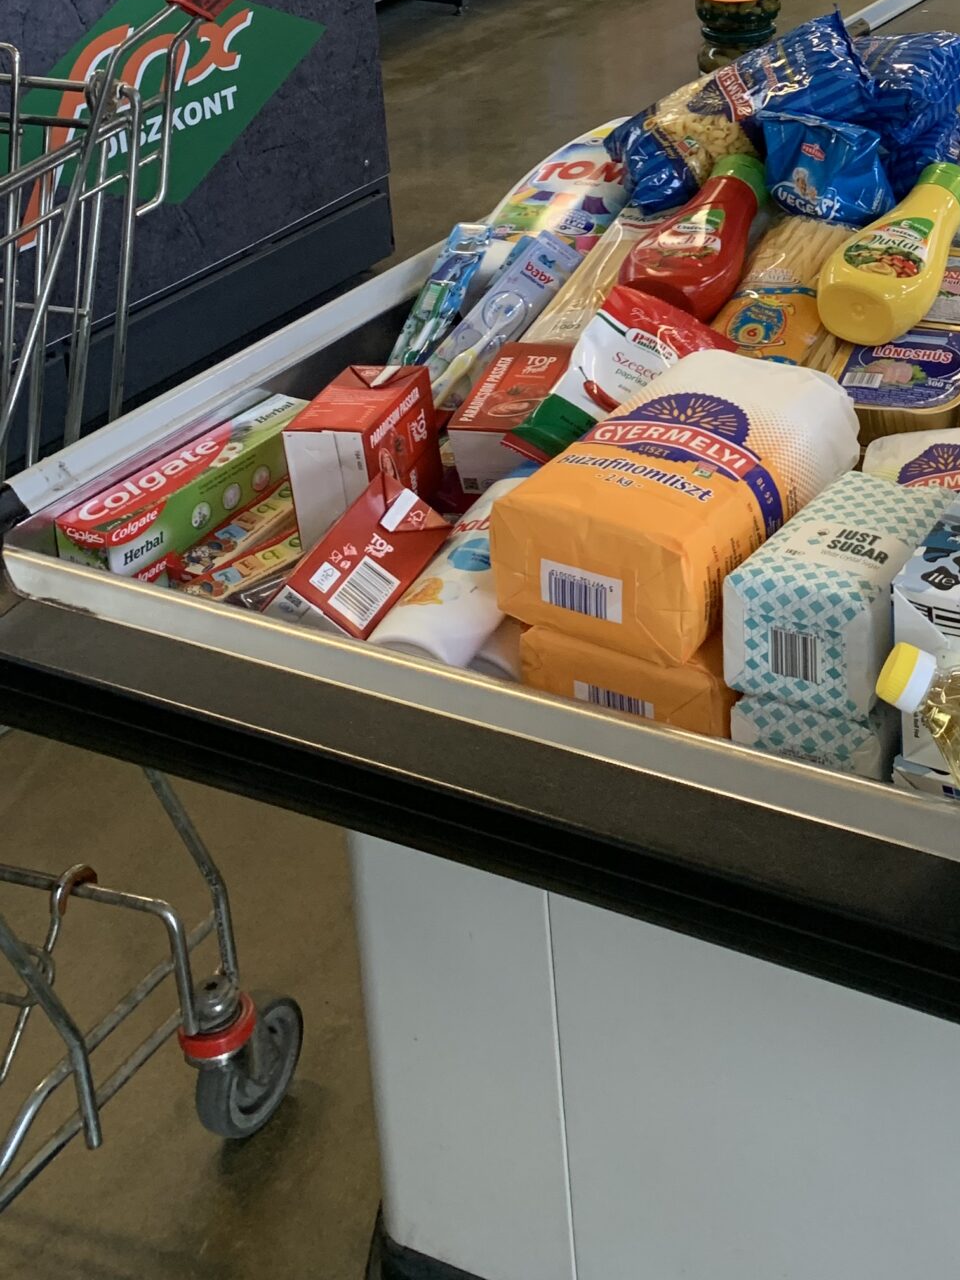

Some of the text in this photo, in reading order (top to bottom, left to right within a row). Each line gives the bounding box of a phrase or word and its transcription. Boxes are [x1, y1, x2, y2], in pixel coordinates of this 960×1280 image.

[534, 158, 627, 186] TOM
[524, 261, 555, 285] baby
[527, 355, 558, 369] TOP
[612, 351, 663, 381] Szeged
[872, 345, 954, 364] LÖNCSHÚS
[459, 356, 515, 423] PARADICSOM PASSATA
[615, 368, 648, 387] paprika
[254, 401, 295, 425] Herbal
[369, 386, 420, 449] PARADICSOM PASSATA
[415, 408, 428, 440] TOP
[593, 424, 748, 470] GYERMELYI
[638, 444, 671, 457] LISZT
[77, 437, 220, 521] Colgate
[614, 476, 634, 487] kg
[111, 509, 159, 542] Colgate
[835, 528, 883, 547] JUST
[122, 531, 165, 567] Herbal
[371, 532, 394, 554] TOP
[826, 539, 889, 565] SUGAR
[136, 559, 168, 582] lgate
[820, 548, 881, 571] White Crystal Sugar
